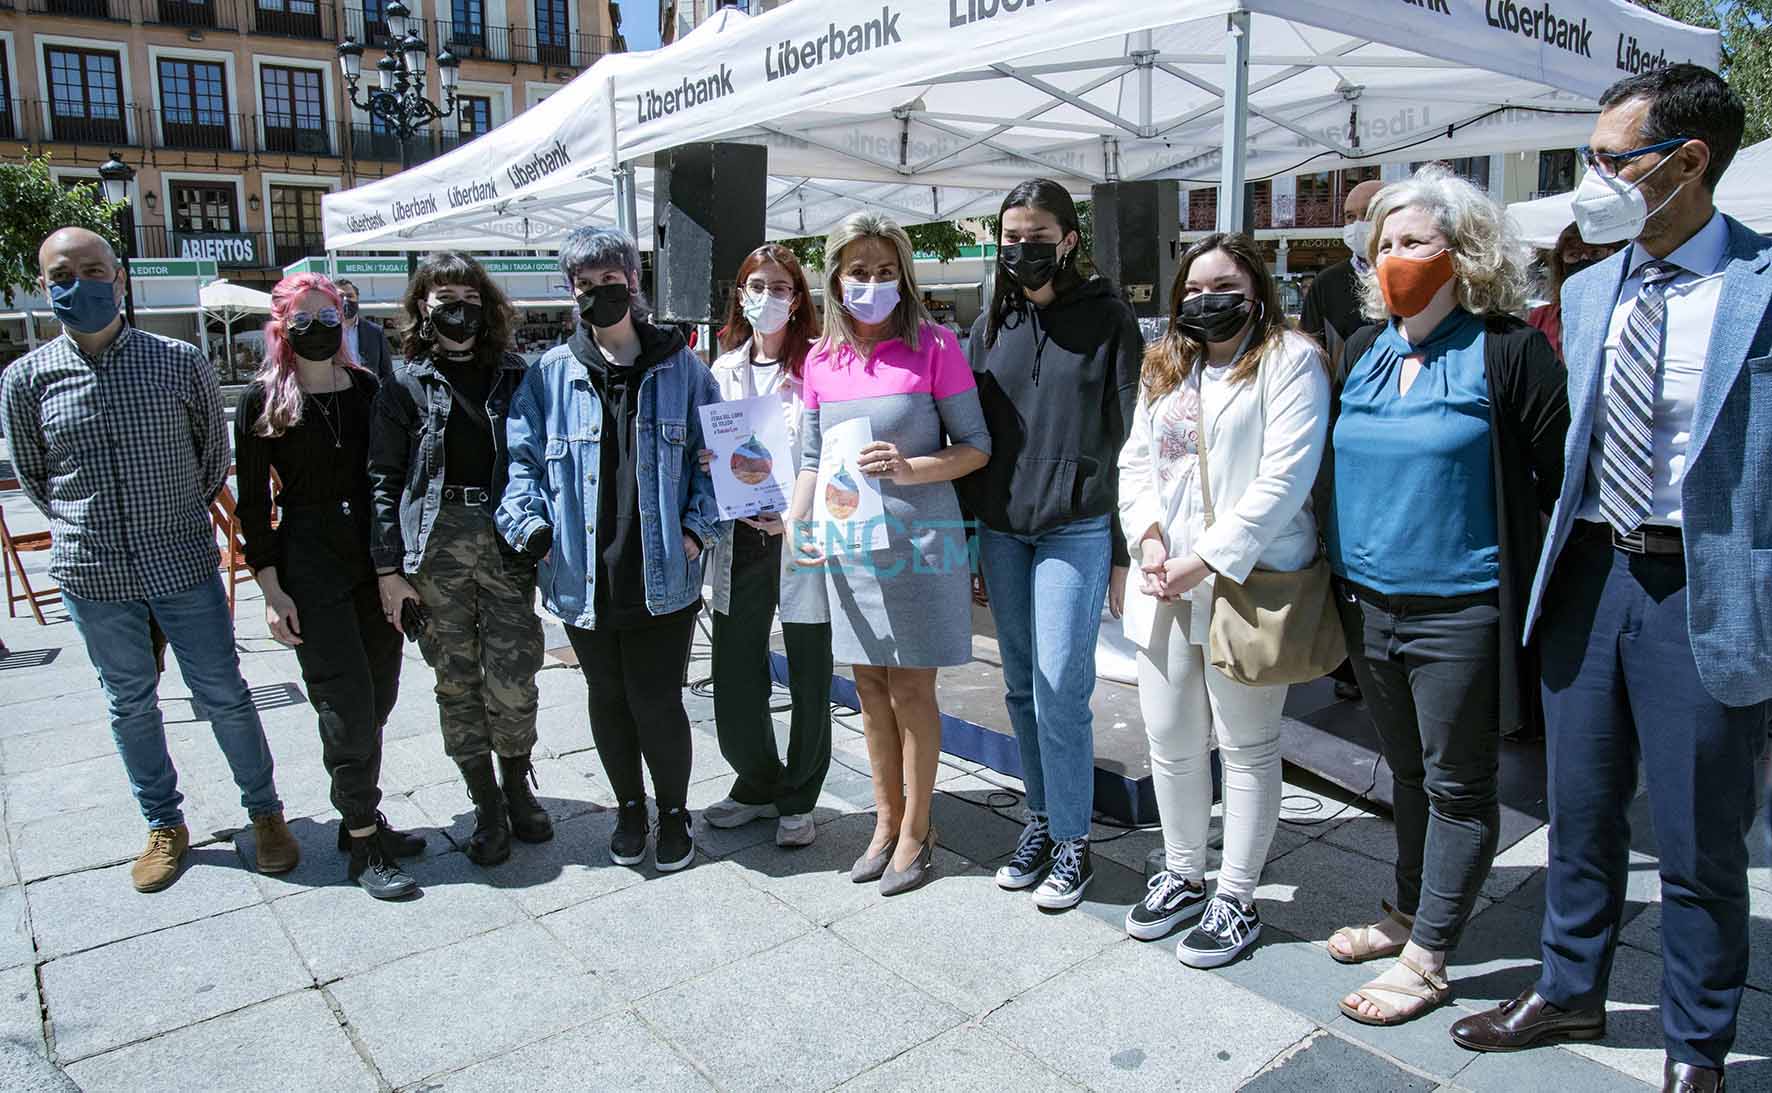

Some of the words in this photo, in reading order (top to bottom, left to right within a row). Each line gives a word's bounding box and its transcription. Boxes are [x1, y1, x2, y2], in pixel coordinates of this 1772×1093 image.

[765, 5, 902, 82] Liberbank
[1485, 0, 1592, 58] Liberbank
[1616, 32, 1676, 75] Liberb
[636, 63, 735, 124] Liberbank
[507, 140, 571, 190] Liberbank
[391, 193, 438, 223] Liberbank
[447, 176, 499, 209] Liberbank
[346, 210, 386, 233] Liberbank
[181, 239, 254, 262] ABIERTOS
[137, 266, 169, 275] EDITOR
